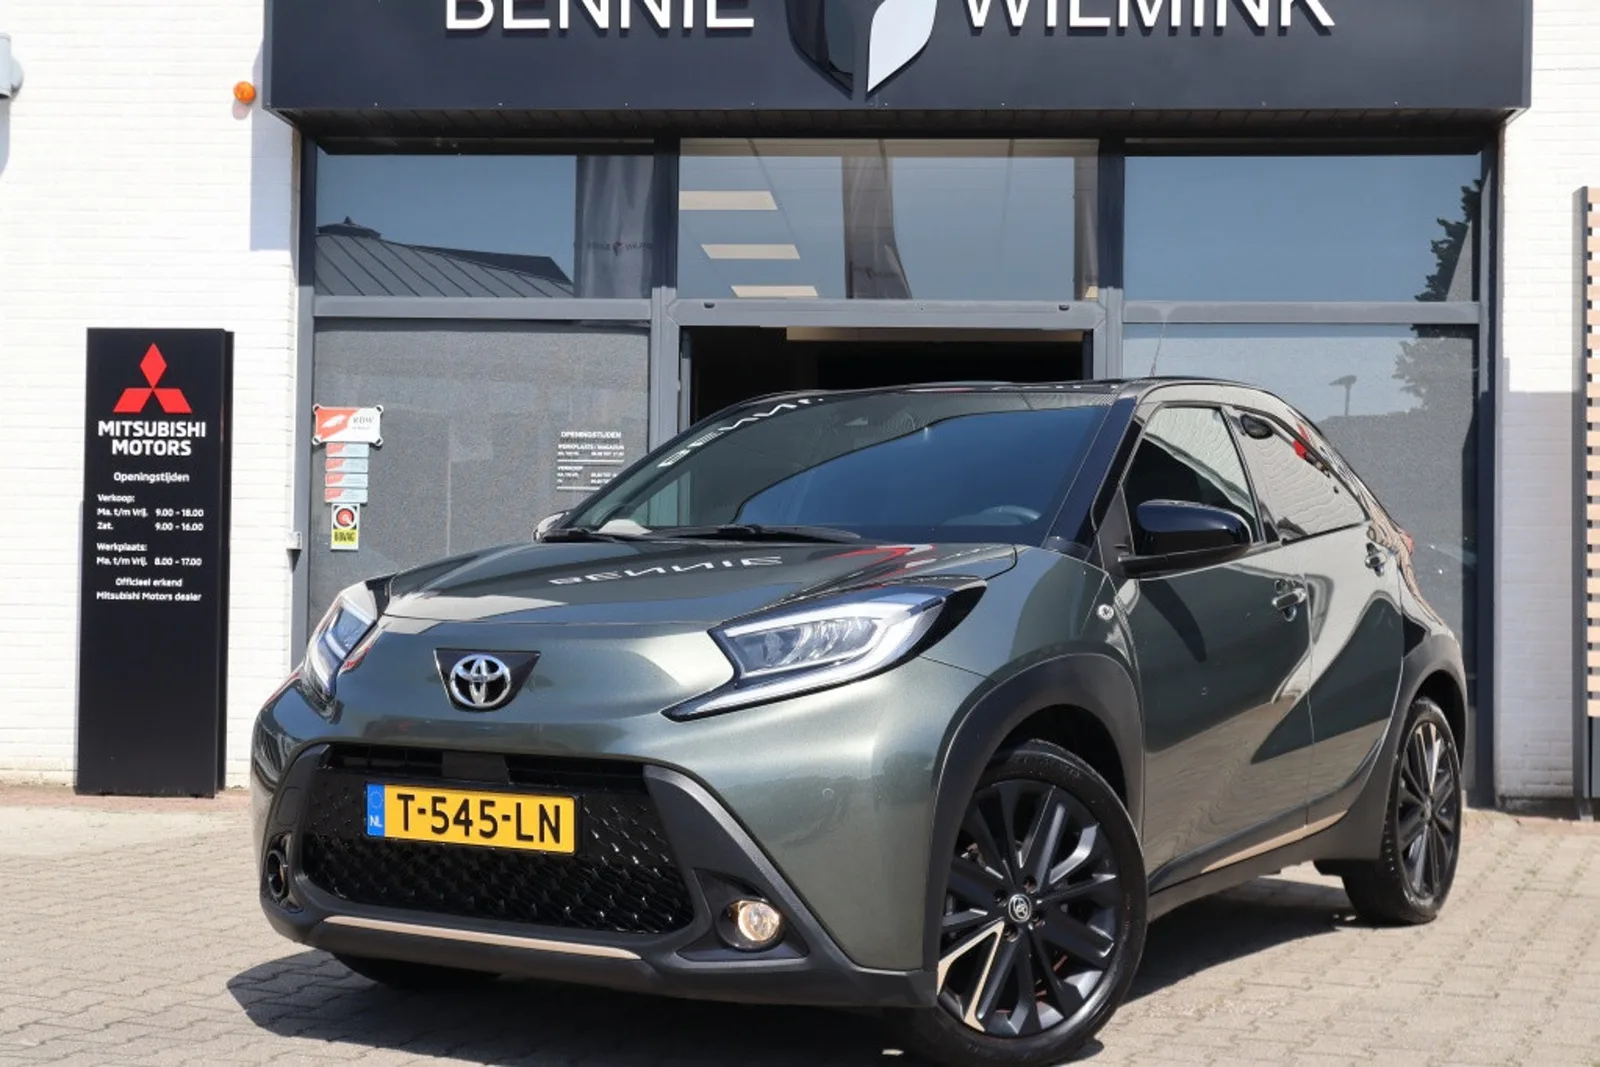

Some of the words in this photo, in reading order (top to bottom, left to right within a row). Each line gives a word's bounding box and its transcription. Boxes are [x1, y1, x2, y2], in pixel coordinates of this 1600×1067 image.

[98, 420, 206, 437] MITSUBISHI
[112, 439, 192, 456] MOTORS
[113, 471, 190, 484] Openingstijden
[97, 494, 135, 504] Verkoop:
[97, 508, 112, 516] Ma.
[114, 508, 131, 516] t/m
[155, 508, 174, 517] 9.00
[181, 508, 204, 517] 18.00
[97, 522, 114, 530] Zat.
[155, 522, 174, 531] 9.00
[96, 543, 148, 553] Werkplaats:
[113, 557, 130, 566] t/m
[181, 557, 203, 566] 17.00
[115, 577, 151, 586] Officieel
[152, 578, 183, 587] erkend
[96, 591, 141, 600] Mitsubishi
[142, 592, 173, 601] Motors
[174, 593, 202, 601] dealer
[369, 816, 383, 828] NL
[396, 793, 561, 844] T-545-LN
